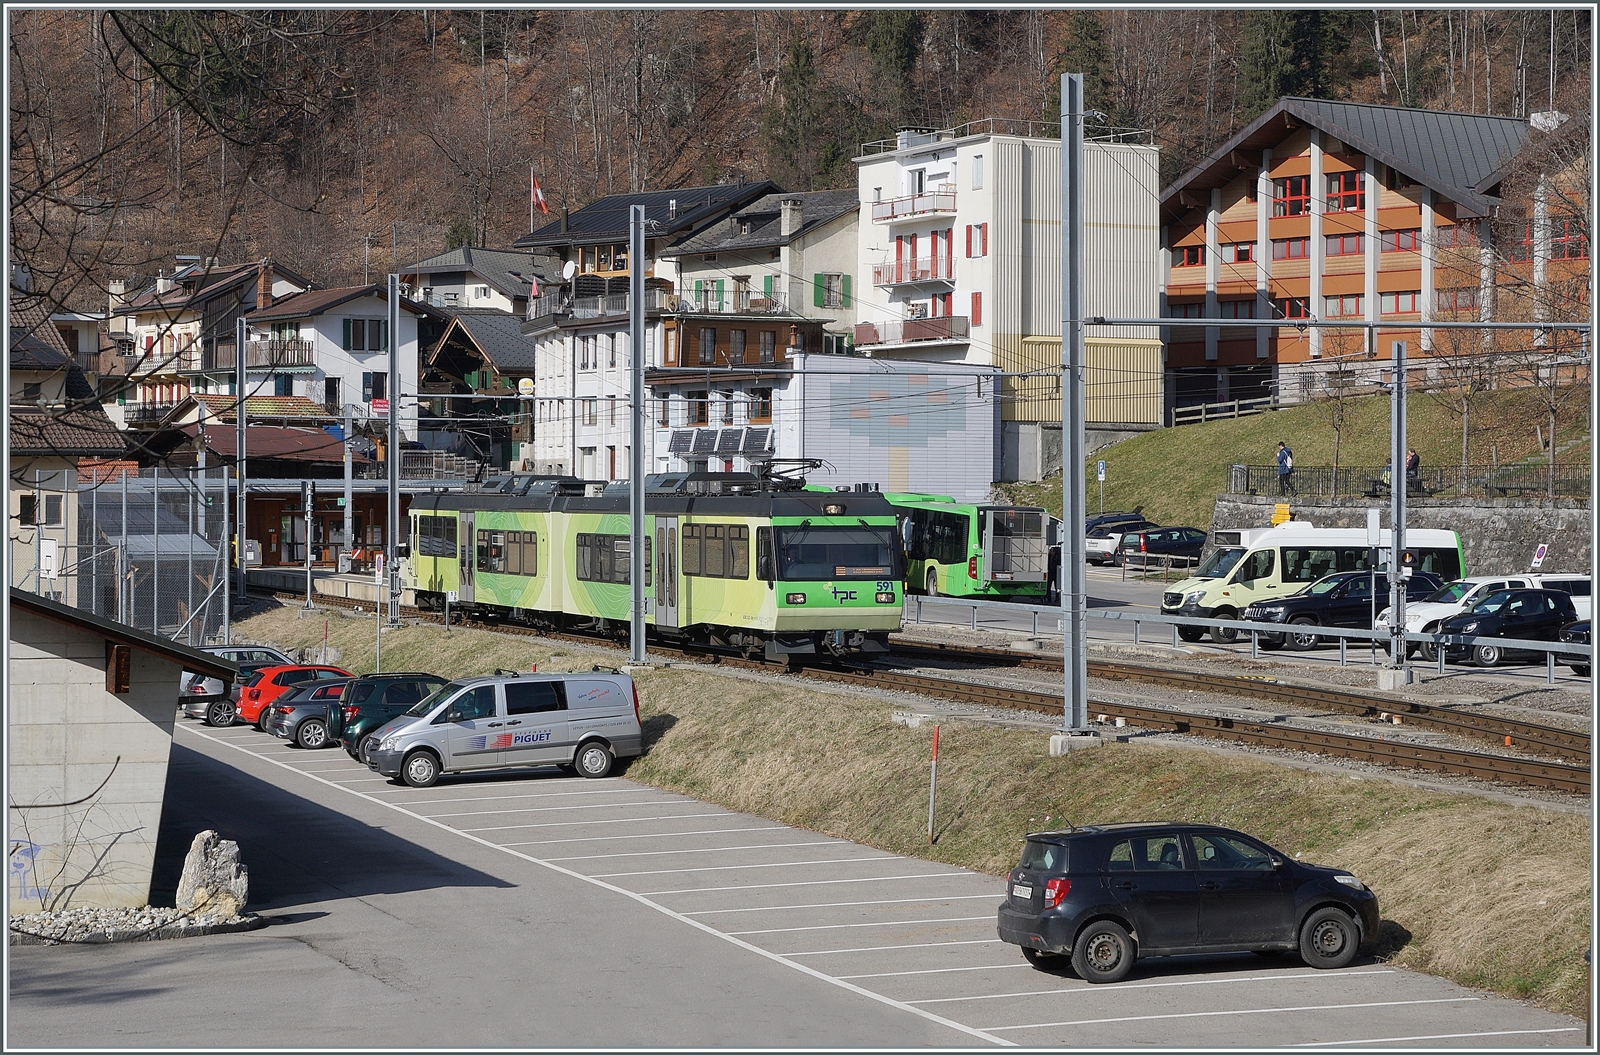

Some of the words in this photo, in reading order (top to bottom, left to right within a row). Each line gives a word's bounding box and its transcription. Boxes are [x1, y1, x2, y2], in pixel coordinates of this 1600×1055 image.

[876, 581, 894, 592] 591
[832, 586, 858, 605] tpc
[514, 732, 552, 744] PIGUET
